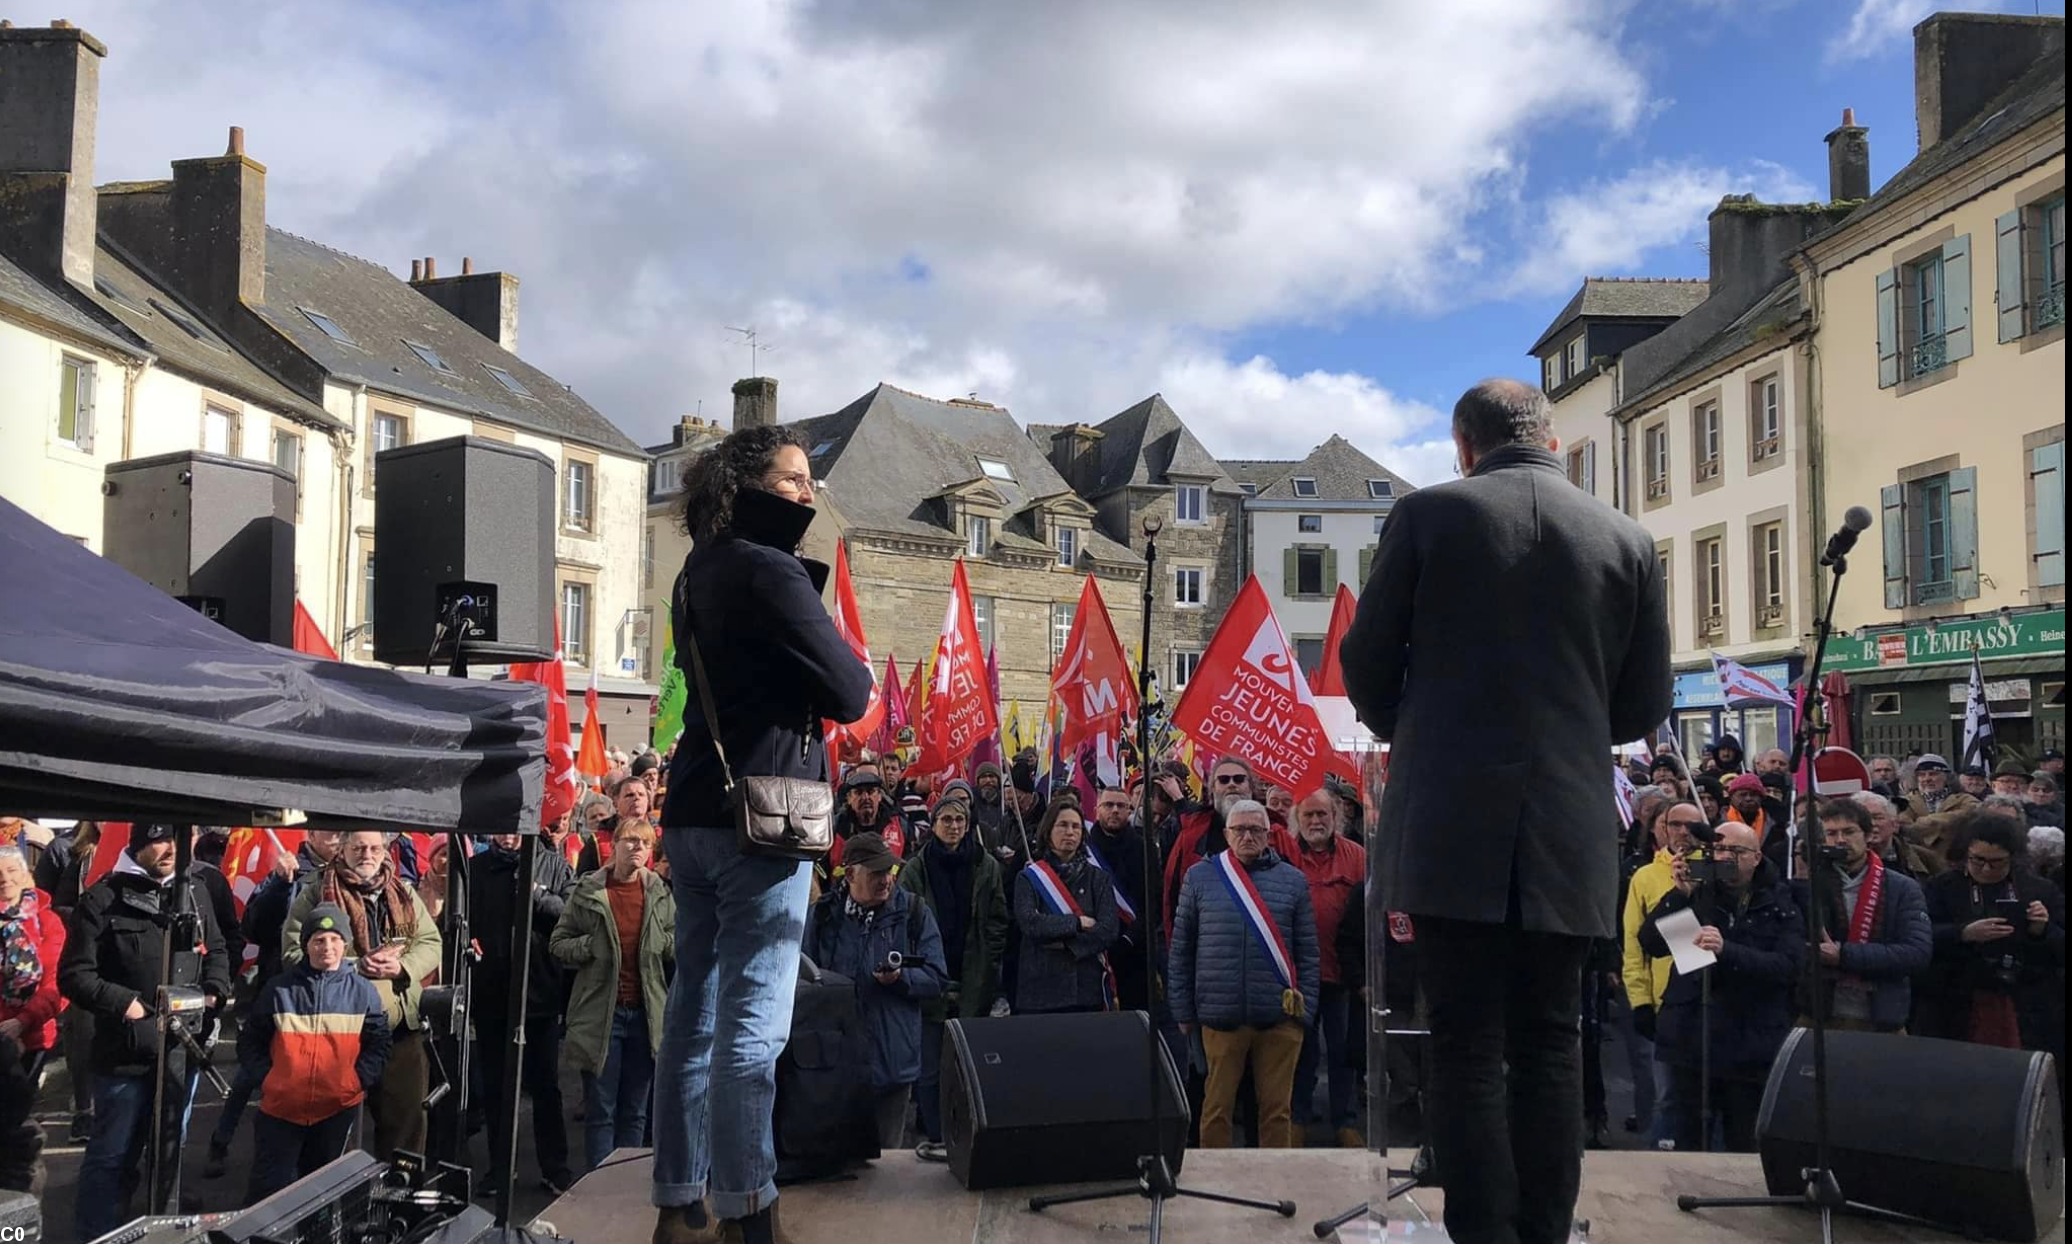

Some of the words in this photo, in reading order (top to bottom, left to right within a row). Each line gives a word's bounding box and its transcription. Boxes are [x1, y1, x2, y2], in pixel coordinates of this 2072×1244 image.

[1912, 624, 2023, 656] L'EMBASSY
[1198, 718, 1226, 742] DE
[1230, 735, 1303, 784] FRANCE
[1211, 705, 1309, 770] COMMUNISTES
[1220, 683, 1317, 757] JEUNES
